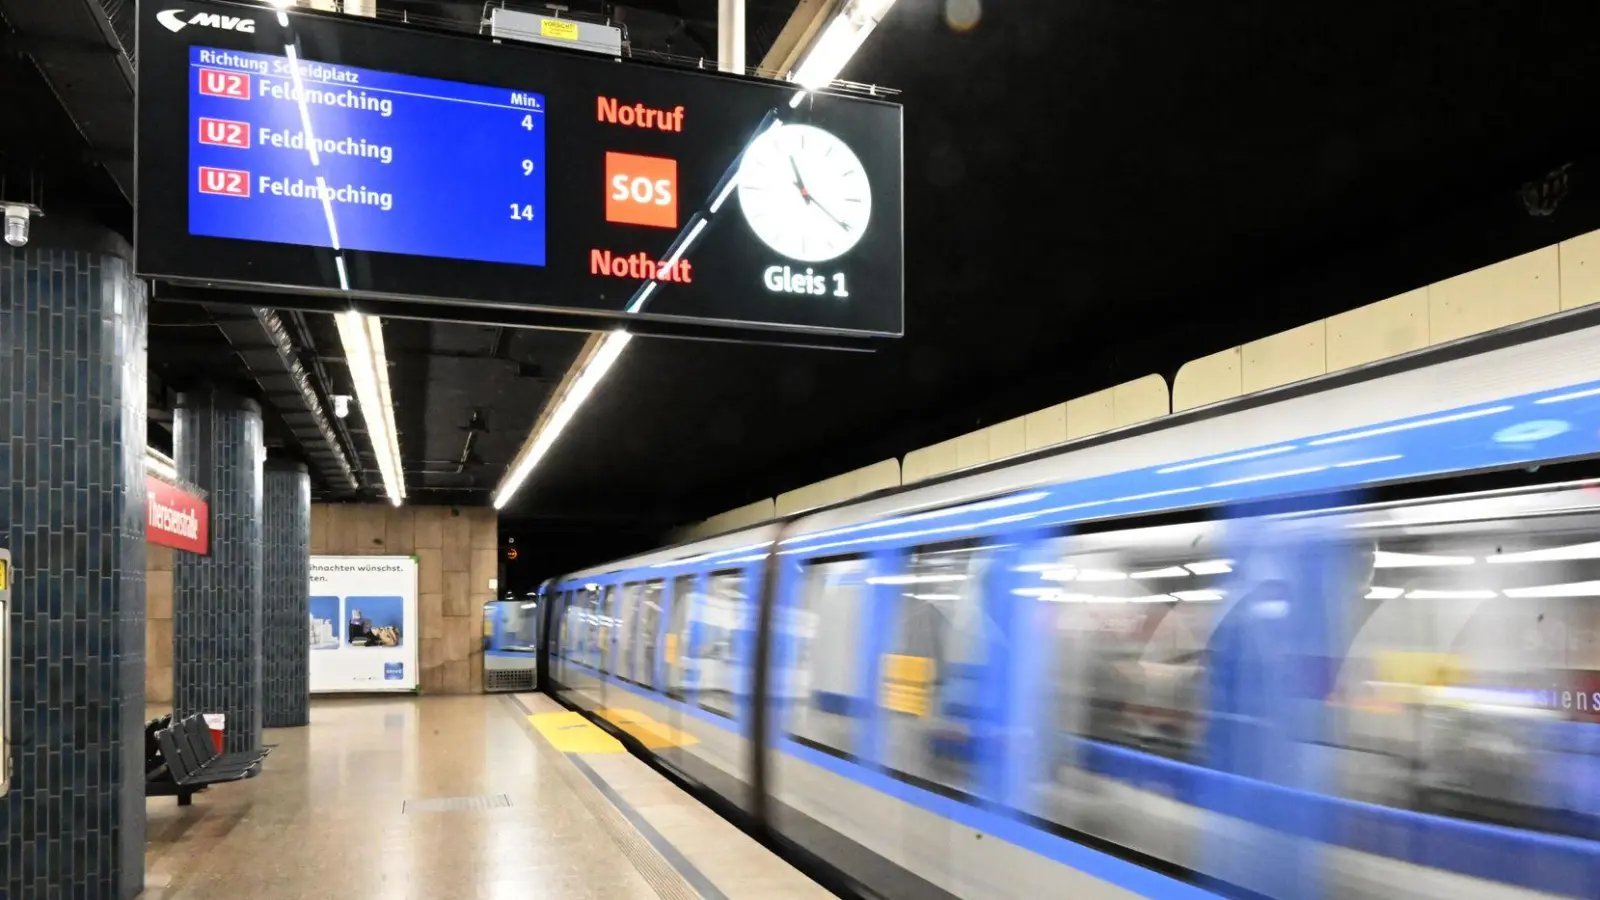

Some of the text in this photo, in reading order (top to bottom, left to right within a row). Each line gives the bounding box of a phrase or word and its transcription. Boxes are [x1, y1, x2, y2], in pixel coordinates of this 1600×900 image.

[187, 12, 255, 33] MVG
[200, 49, 359, 84] Richtung Sceidplatz
[207, 73, 534, 131] U2 Feldmoching 4
[510, 92, 540, 108] Min.
[597, 95, 684, 132] Notruf
[207, 121, 534, 176] U2 Feldmoching 9
[207, 171, 534, 221] U2 Feldmoching 14
[611, 174, 672, 206] SOS
[591, 249, 692, 283] Nothalt
[764, 265, 849, 297] Gleis 1
[357, 564, 404, 572] wünschst.
